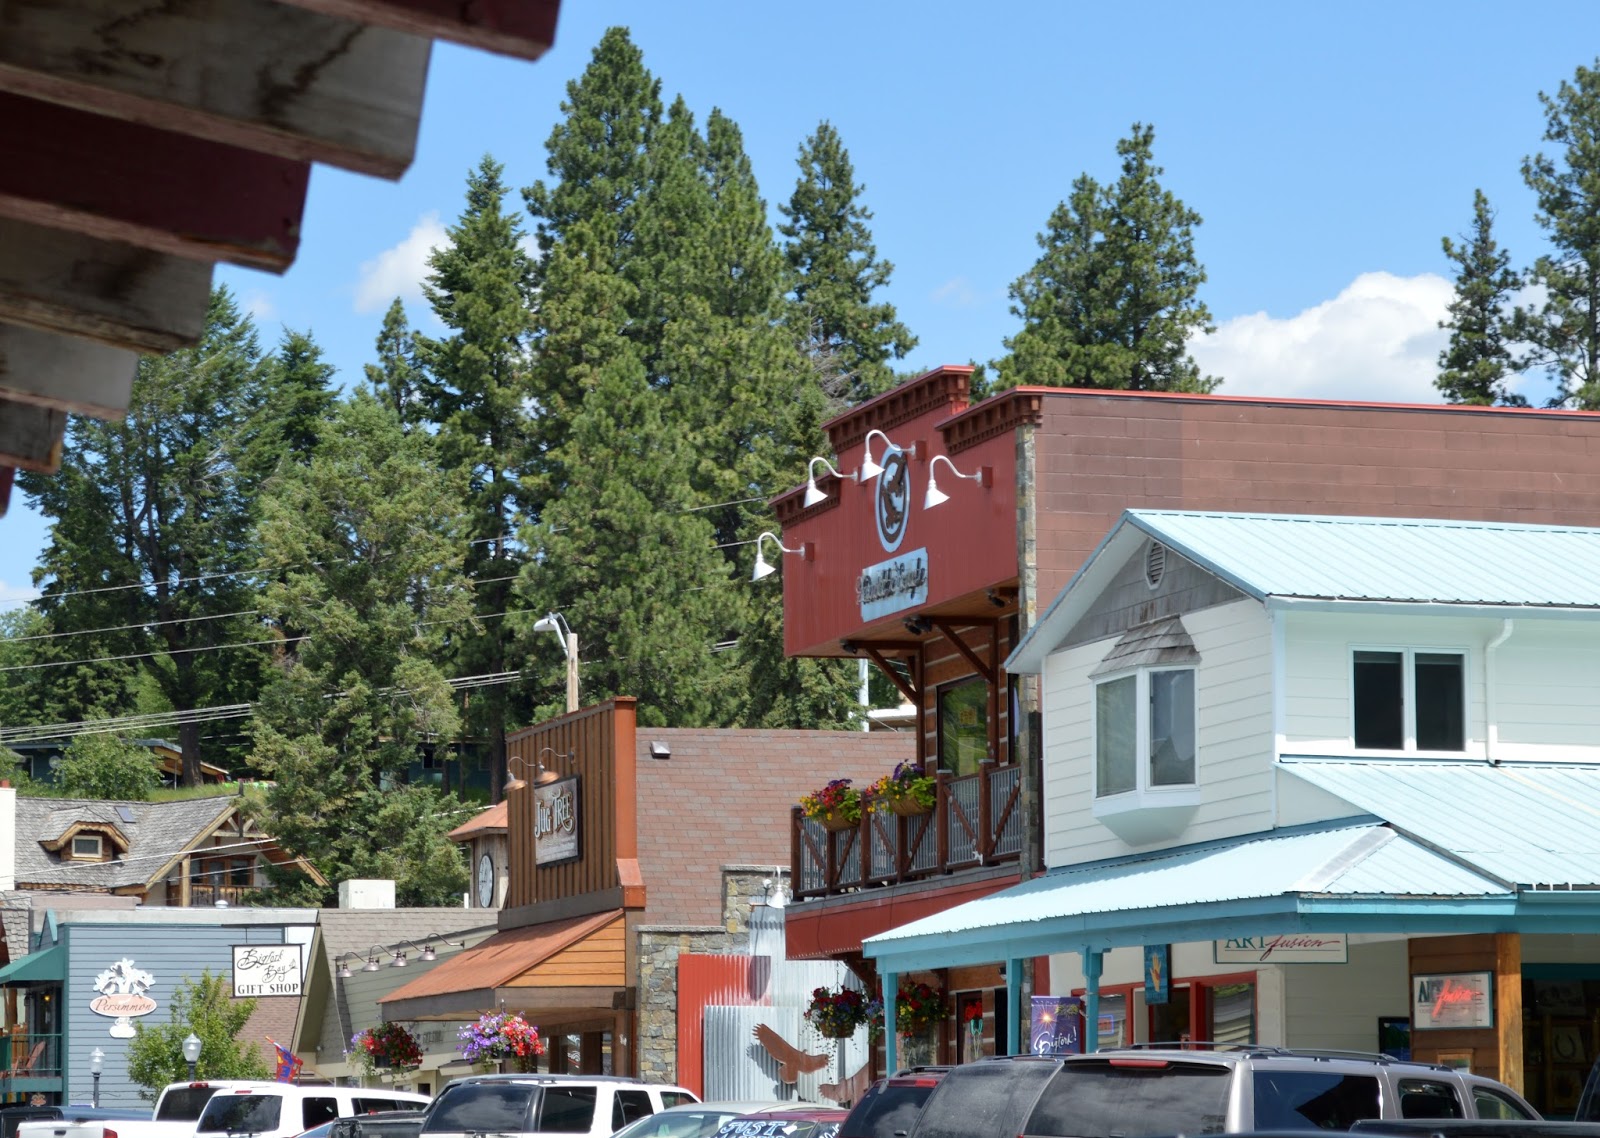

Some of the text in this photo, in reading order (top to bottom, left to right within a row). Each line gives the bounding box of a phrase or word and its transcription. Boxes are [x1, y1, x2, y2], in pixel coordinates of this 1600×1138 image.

[552, 787, 574, 832] TREE
[237, 948, 285, 970] Bigfork
[262, 965, 286, 984] Bay
[237, 983, 299, 995] GIFT SHOP
[95, 999, 152, 1012] Persimmon
[720, 1120, 787, 1136] JUST
